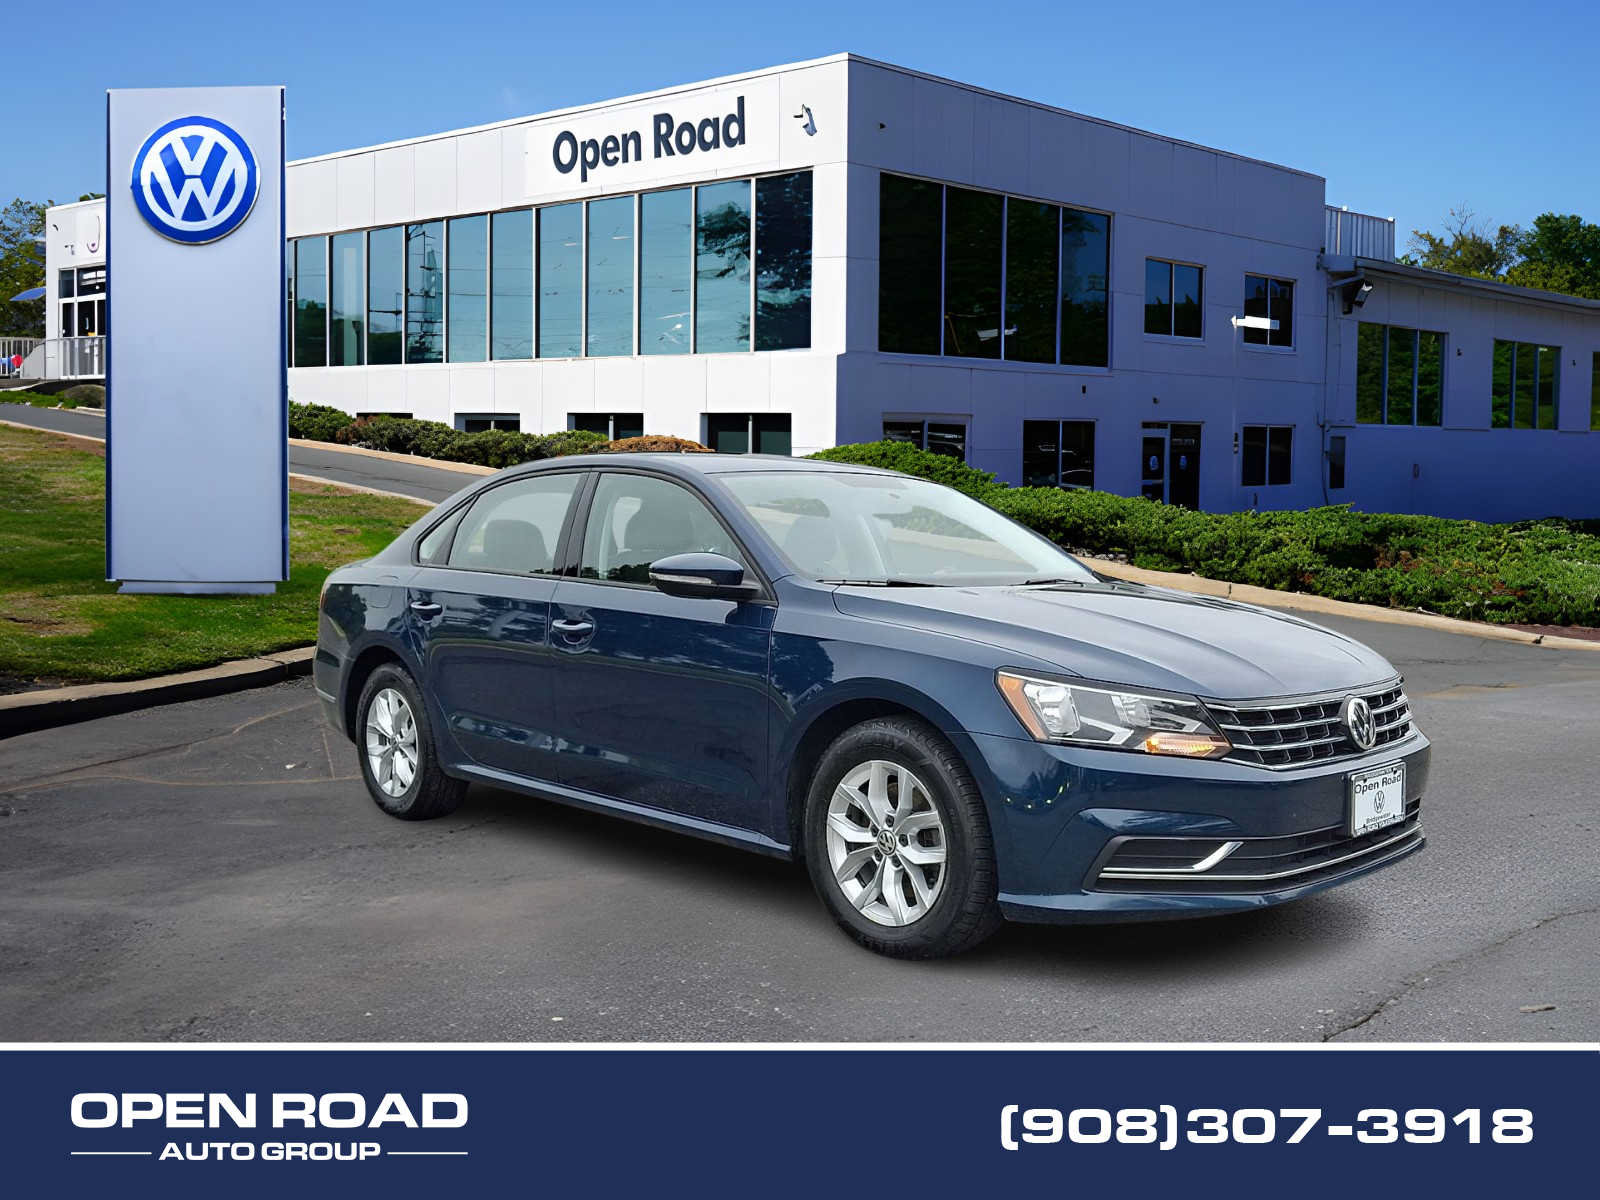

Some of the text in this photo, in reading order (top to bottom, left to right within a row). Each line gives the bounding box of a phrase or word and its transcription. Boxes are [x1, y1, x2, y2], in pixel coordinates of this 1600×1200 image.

[552, 95, 746, 182] Open Road
[1354, 774, 1402, 795] Open Road
